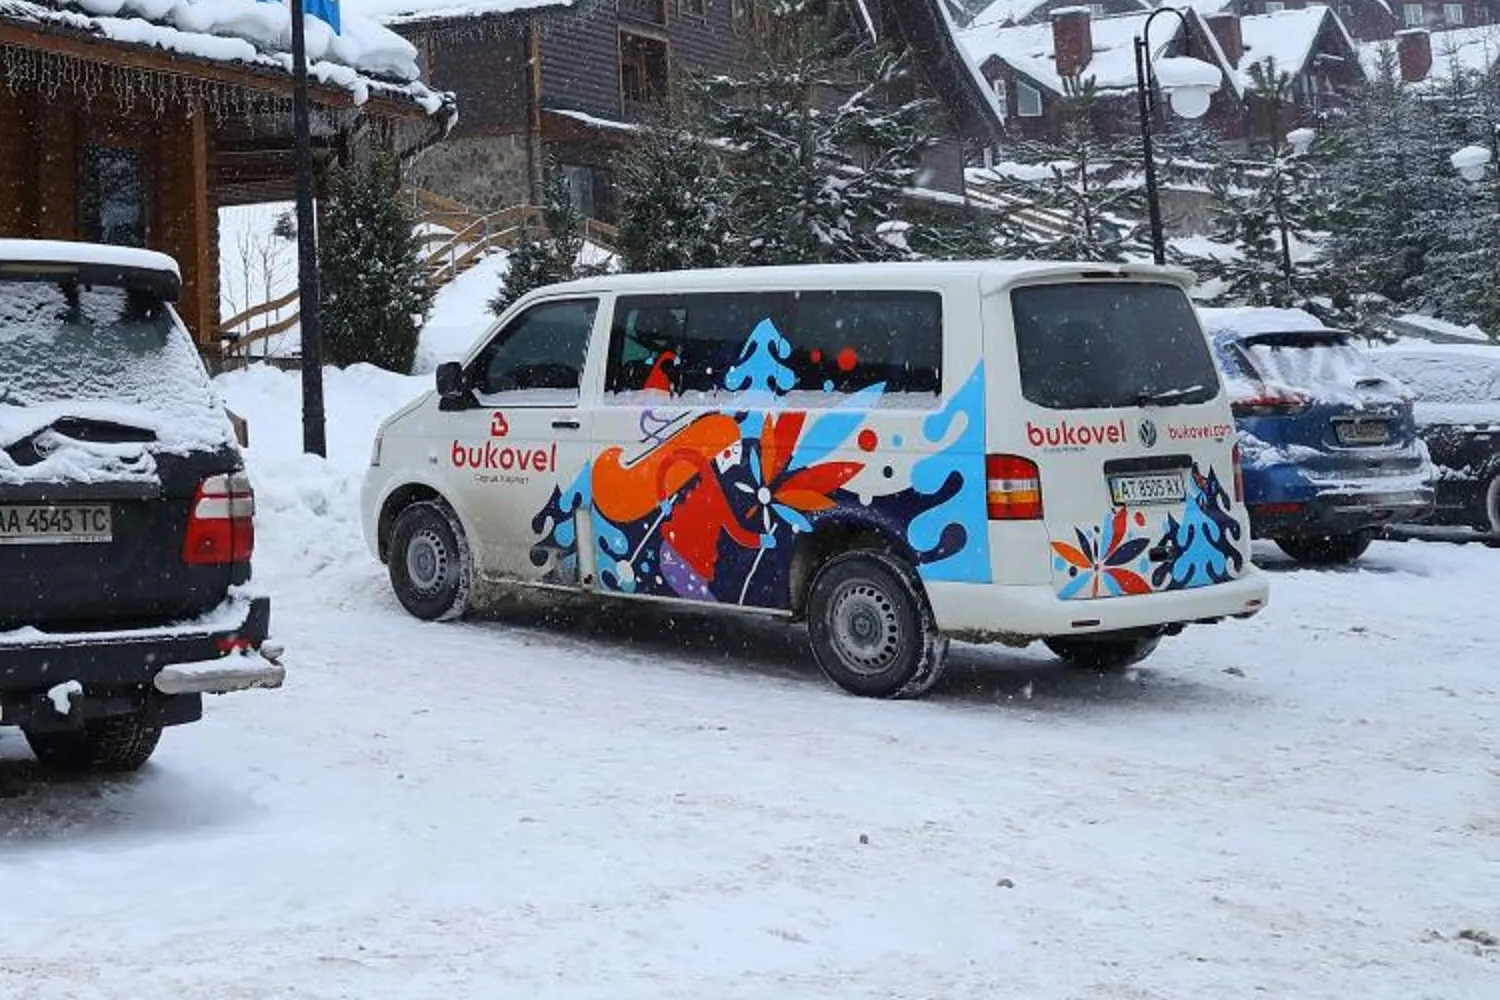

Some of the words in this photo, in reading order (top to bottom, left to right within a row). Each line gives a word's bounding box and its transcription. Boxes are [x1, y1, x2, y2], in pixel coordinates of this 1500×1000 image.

[1026, 419, 1128, 447] bukovel
[451, 439, 558, 473] bukovel
[25, 508, 74, 533] 4545
[77, 508, 108, 532] TC
